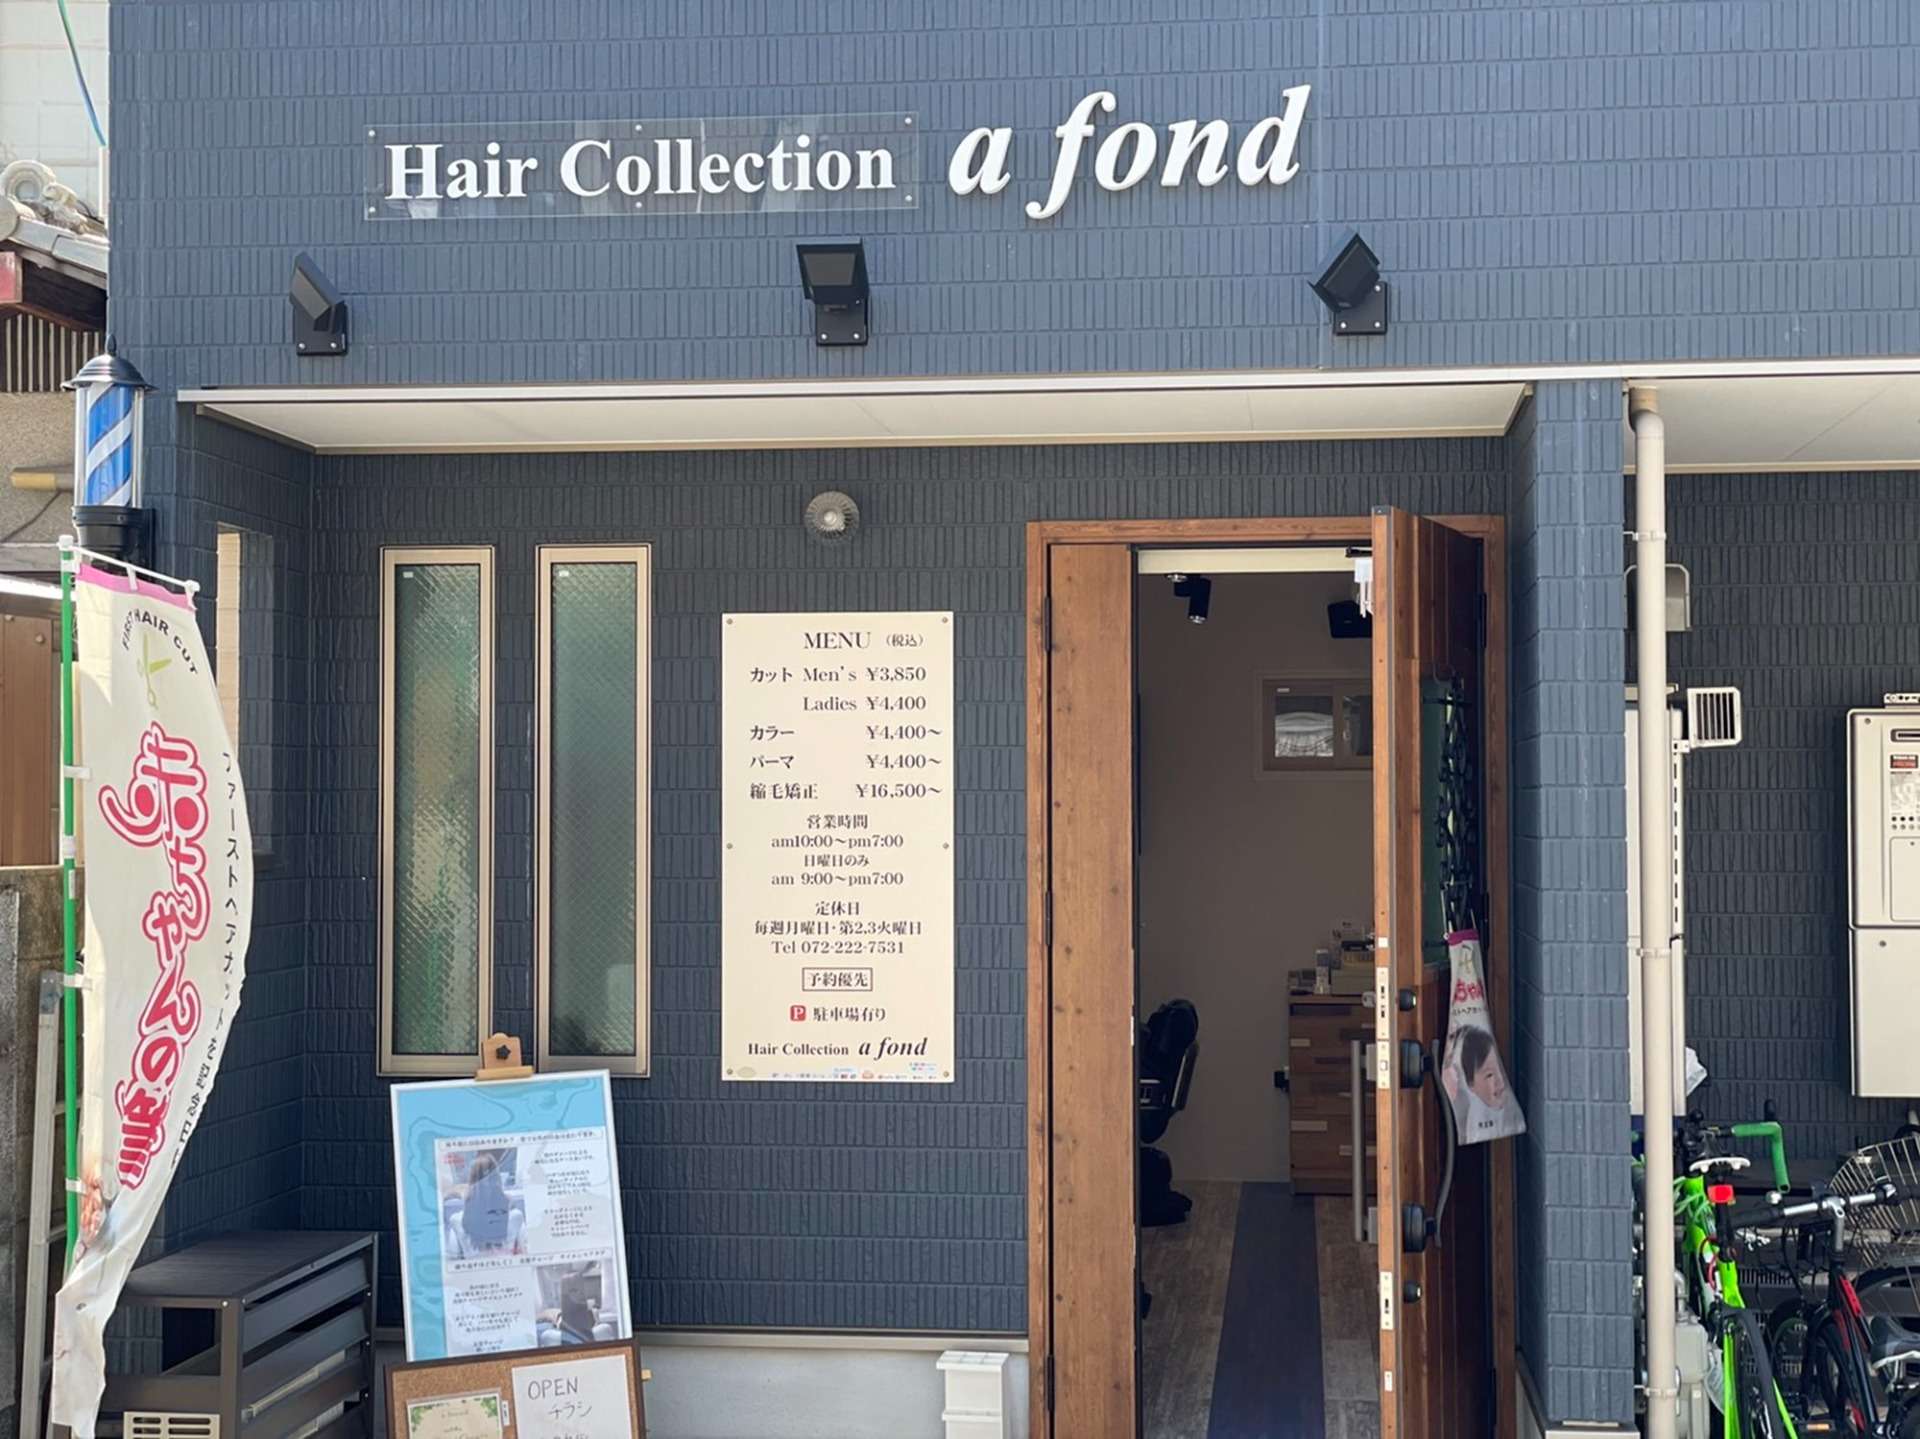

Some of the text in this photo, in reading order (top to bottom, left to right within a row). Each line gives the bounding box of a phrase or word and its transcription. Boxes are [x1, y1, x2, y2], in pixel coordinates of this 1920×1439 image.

[384, 84, 1312, 220] Hair Collection a fond
[134, 608, 169, 636] HAIR
[173, 635, 199, 675] CUT
[803, 631, 871, 650] MENU
[750, 666, 793, 683] カット
[866, 666, 927, 682] ¥3,850
[803, 695, 927, 712] Ladies ¥4,400
[749, 724, 795, 741] カラー
[750, 754, 795, 770] パーマ
[749, 782, 819, 800] 縮毛矯正
[806, 814, 869, 830] 営業時間
[804, 853, 870, 868] 日曜日のみ
[771, 875, 795, 886] am
[815, 900, 860, 917] 定休日
[770, 940, 904, 955] Tel 072-222-7531
[806, 970, 870, 989] 予約優先
[813, 1006, 886, 1023] 駐車場有り
[748, 1036, 929, 1062] Hair Collection a fond
[527, 1376, 578, 1400] OPEN
[547, 1400, 593, 1420] チラシ
